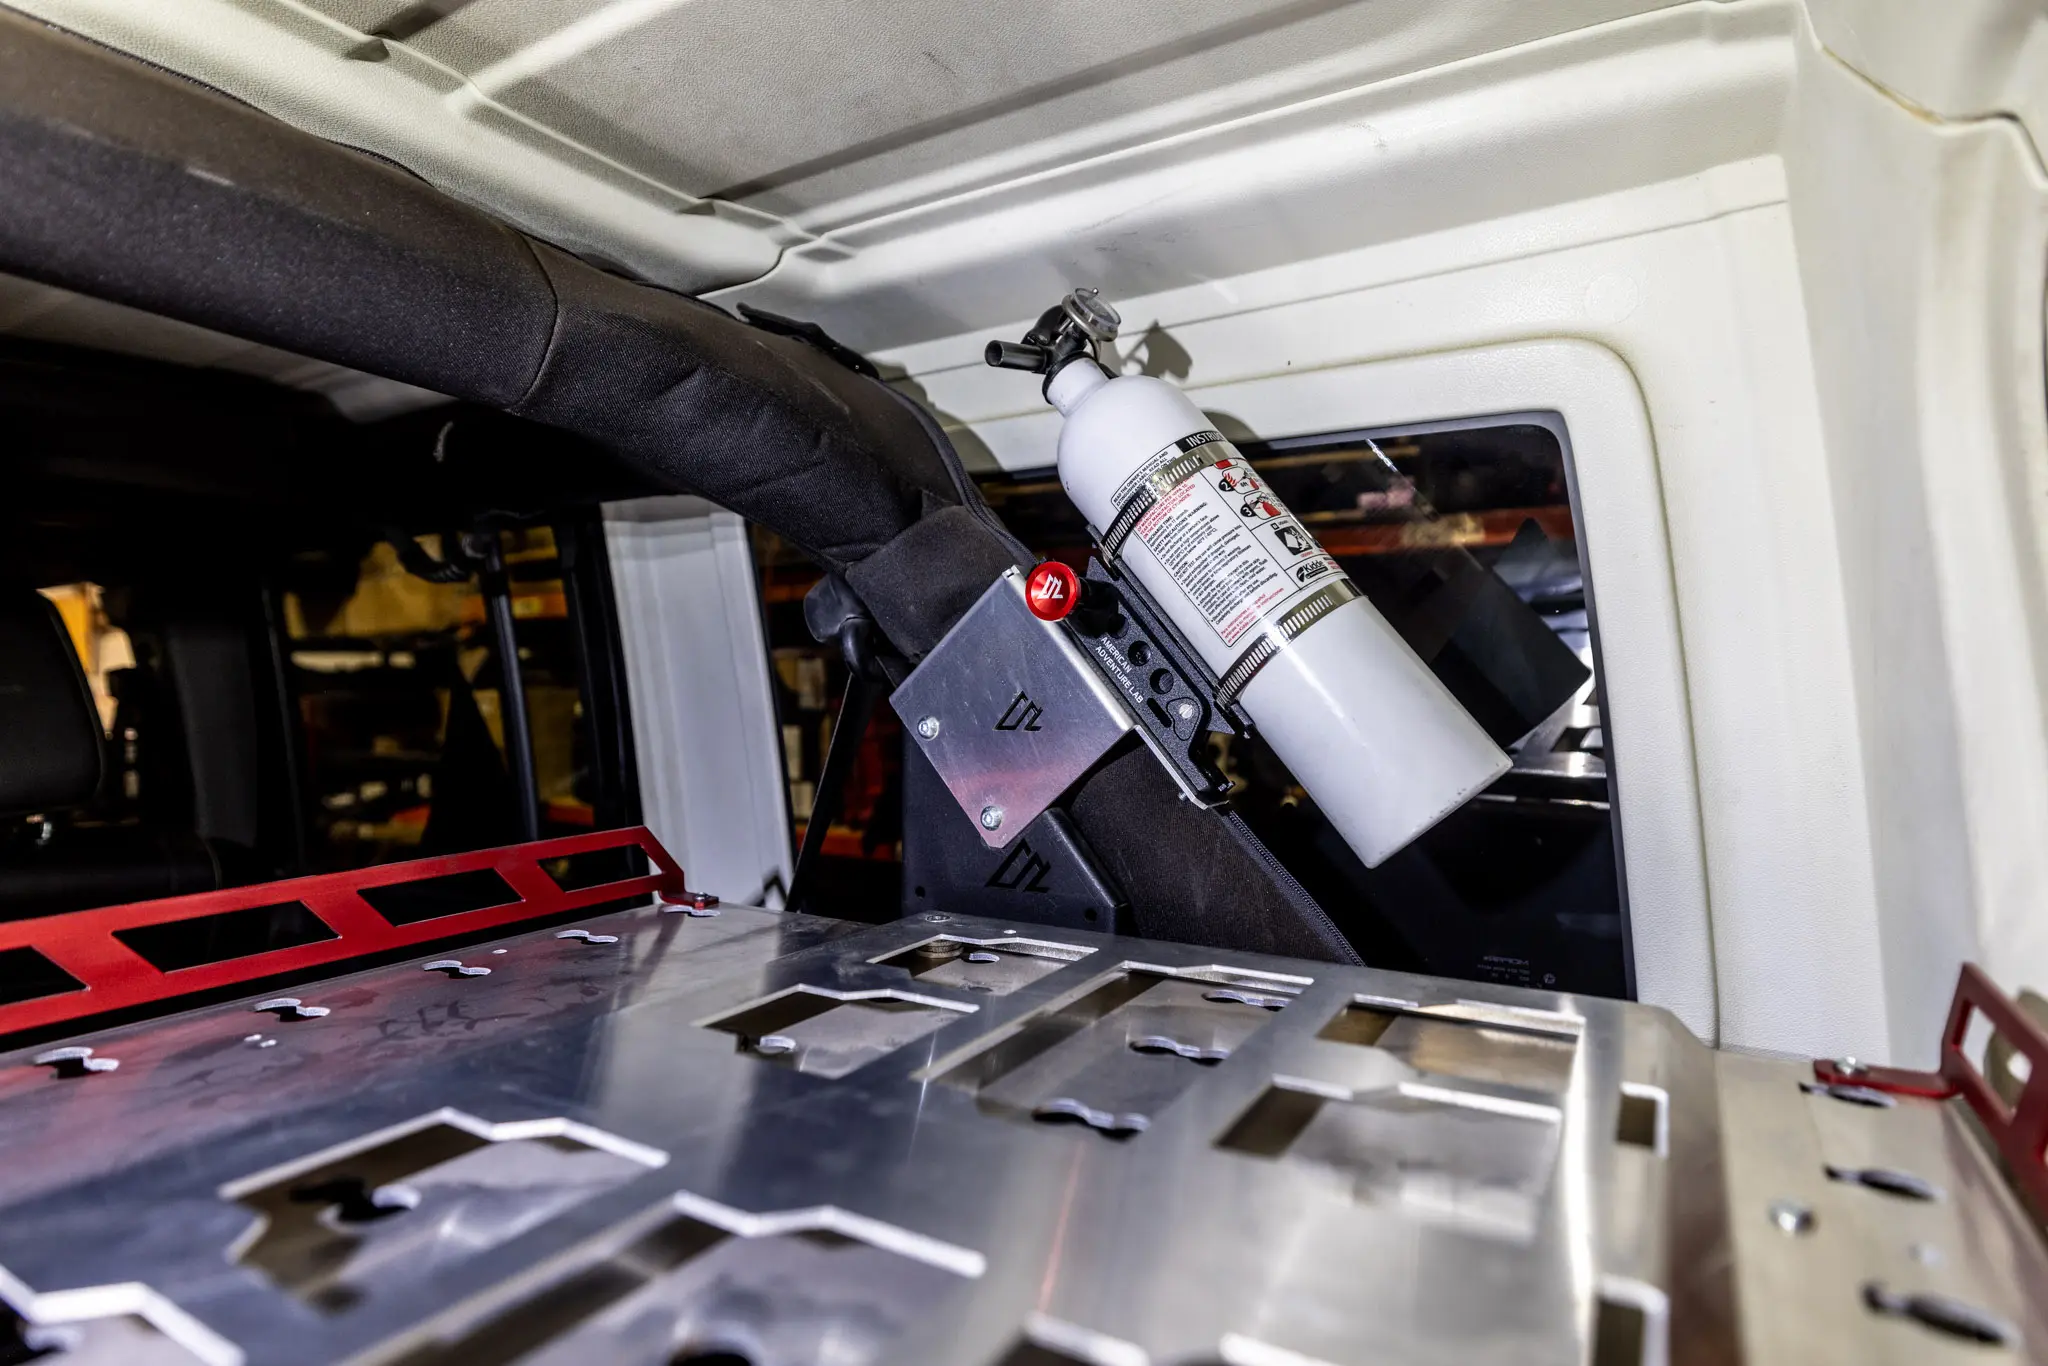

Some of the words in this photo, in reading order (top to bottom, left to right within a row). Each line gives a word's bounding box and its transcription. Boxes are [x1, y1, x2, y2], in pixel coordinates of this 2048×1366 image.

[1221, 482, 1231, 490] 2
[1243, 507, 1252, 516] 3
[1303, 560, 1325, 572] Kidde
[1101, 636, 1132, 674] AMERICAN
[1096, 646, 1132, 689] ADVENTURE
[1128, 686, 1144, 704] LAB
